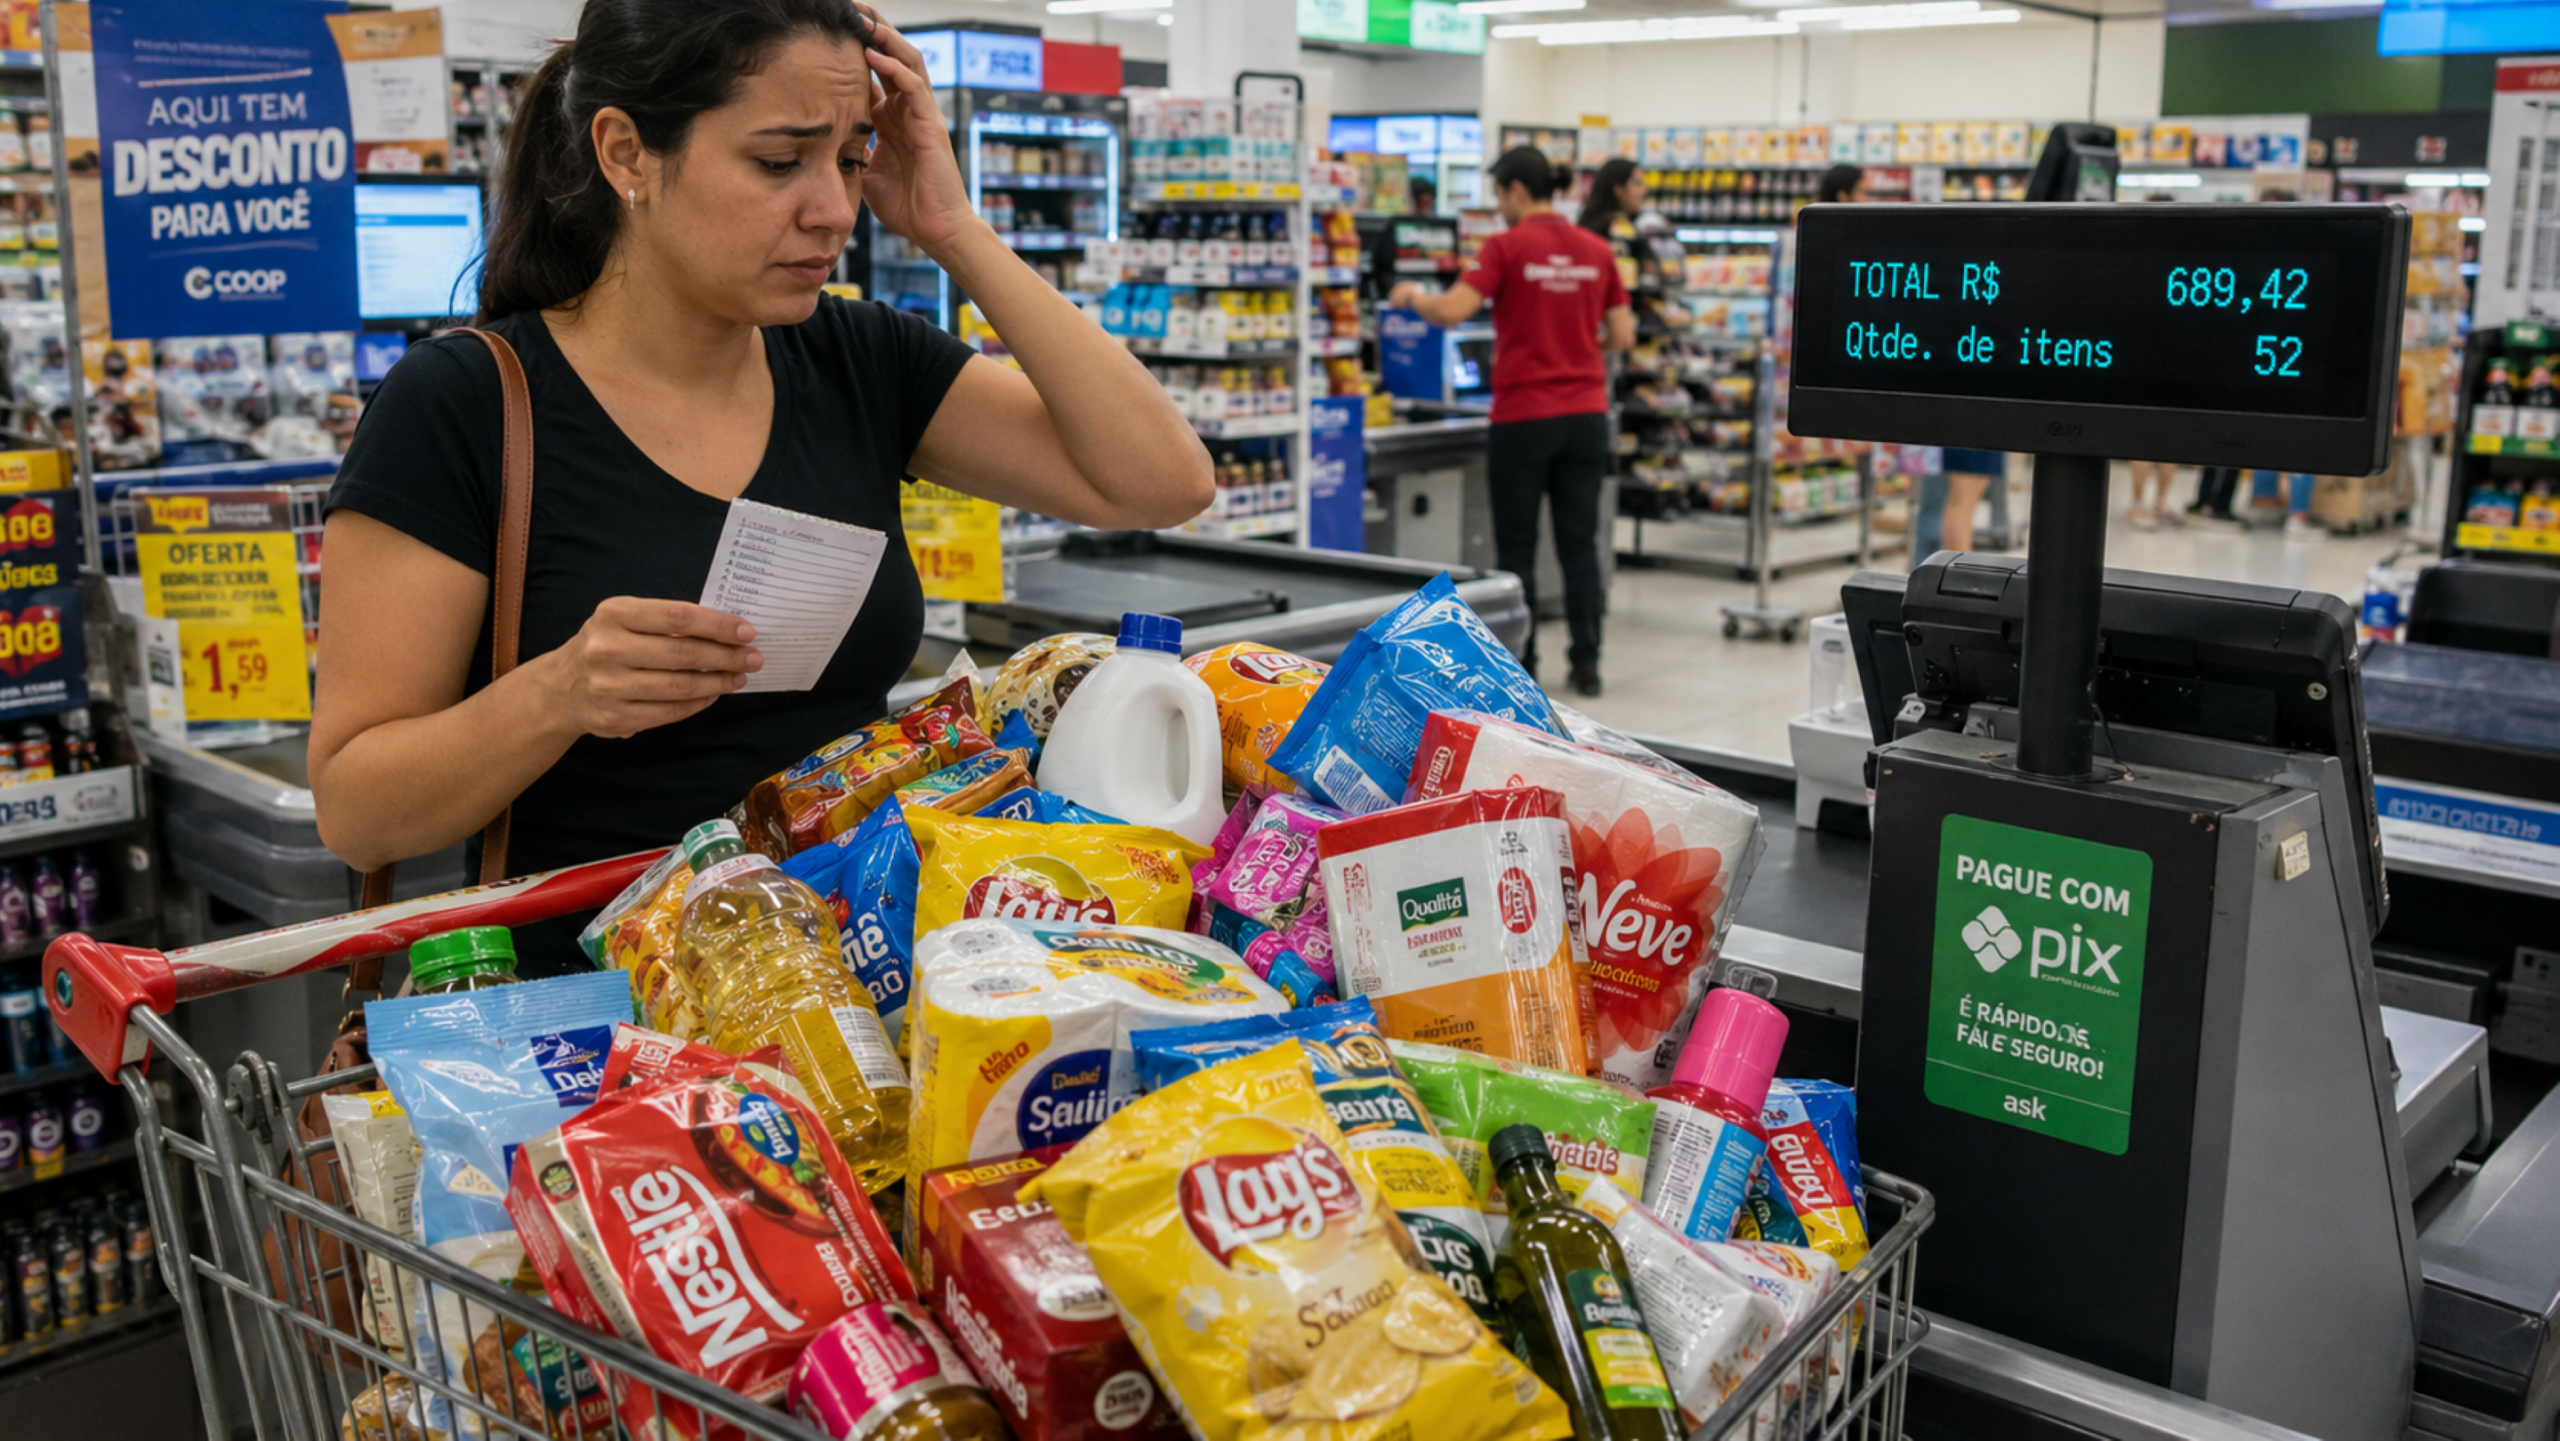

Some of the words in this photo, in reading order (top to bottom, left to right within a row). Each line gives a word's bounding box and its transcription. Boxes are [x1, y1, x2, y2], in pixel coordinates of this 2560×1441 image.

[147, 95, 232, 129] AQUI
[238, 91, 308, 121] TEM
[113, 126, 347, 197] DESCONTO
[151, 201, 232, 240] PARA
[234, 187, 311, 234] VOCÊ
[214, 269, 287, 294] COOP
[1850, 261, 1940, 300] TOTAL
[1962, 261, 2001, 304] R$
[2167, 267, 2309, 313] 689,42
[1845, 321, 1932, 360] Qtde.
[1957, 325, 1995, 363] de
[2019, 328, 2113, 368] itens
[2254, 335, 2303, 377] 52
[168, 542, 265, 565] OFERTA
[202, 642, 268, 700] 1,59
[1956, 854, 2052, 899] PAGUE
[2059, 877, 2130, 917] COM
[1578, 871, 1692, 967] Neve
[2029, 922, 2123, 985] pix
[1958, 993, 1973, 1019] É
[2009, 1038, 2105, 1080] SEGURO!
[2003, 1094, 2047, 1122] ask
[1193, 1143, 1343, 1254] Lay's
